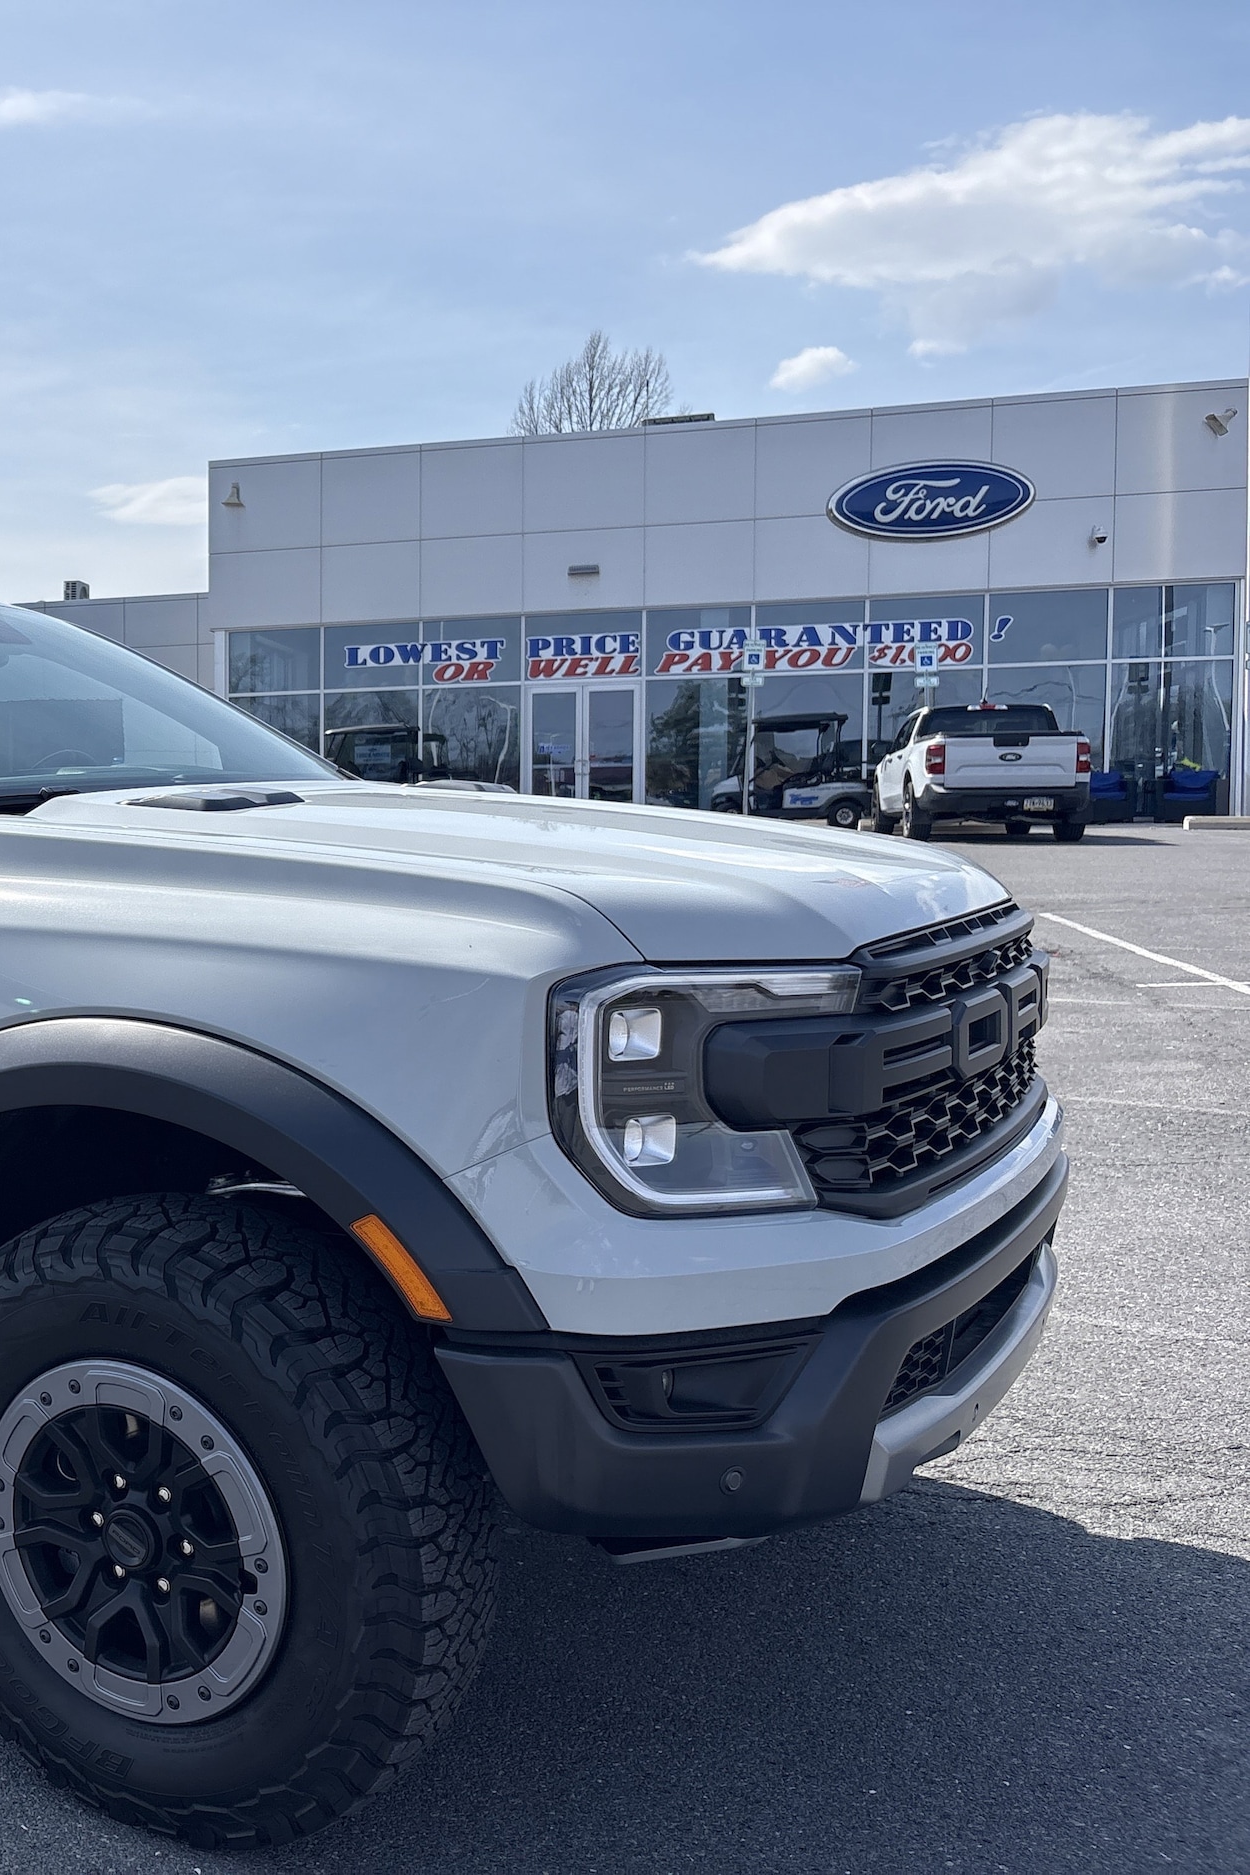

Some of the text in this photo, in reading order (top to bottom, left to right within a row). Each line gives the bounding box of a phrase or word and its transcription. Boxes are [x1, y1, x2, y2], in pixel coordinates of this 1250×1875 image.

[874, 477, 989, 523] Ford
[346, 639, 504, 667] LOWEST
[527, 634, 639, 658] PRICE
[667, 619, 972, 650] GUARANTEED
[433, 661, 495, 682] OR
[528, 655, 639, 678] WE'LL
[655, 650, 743, 673] PAY
[764, 646, 856, 669] YOU
